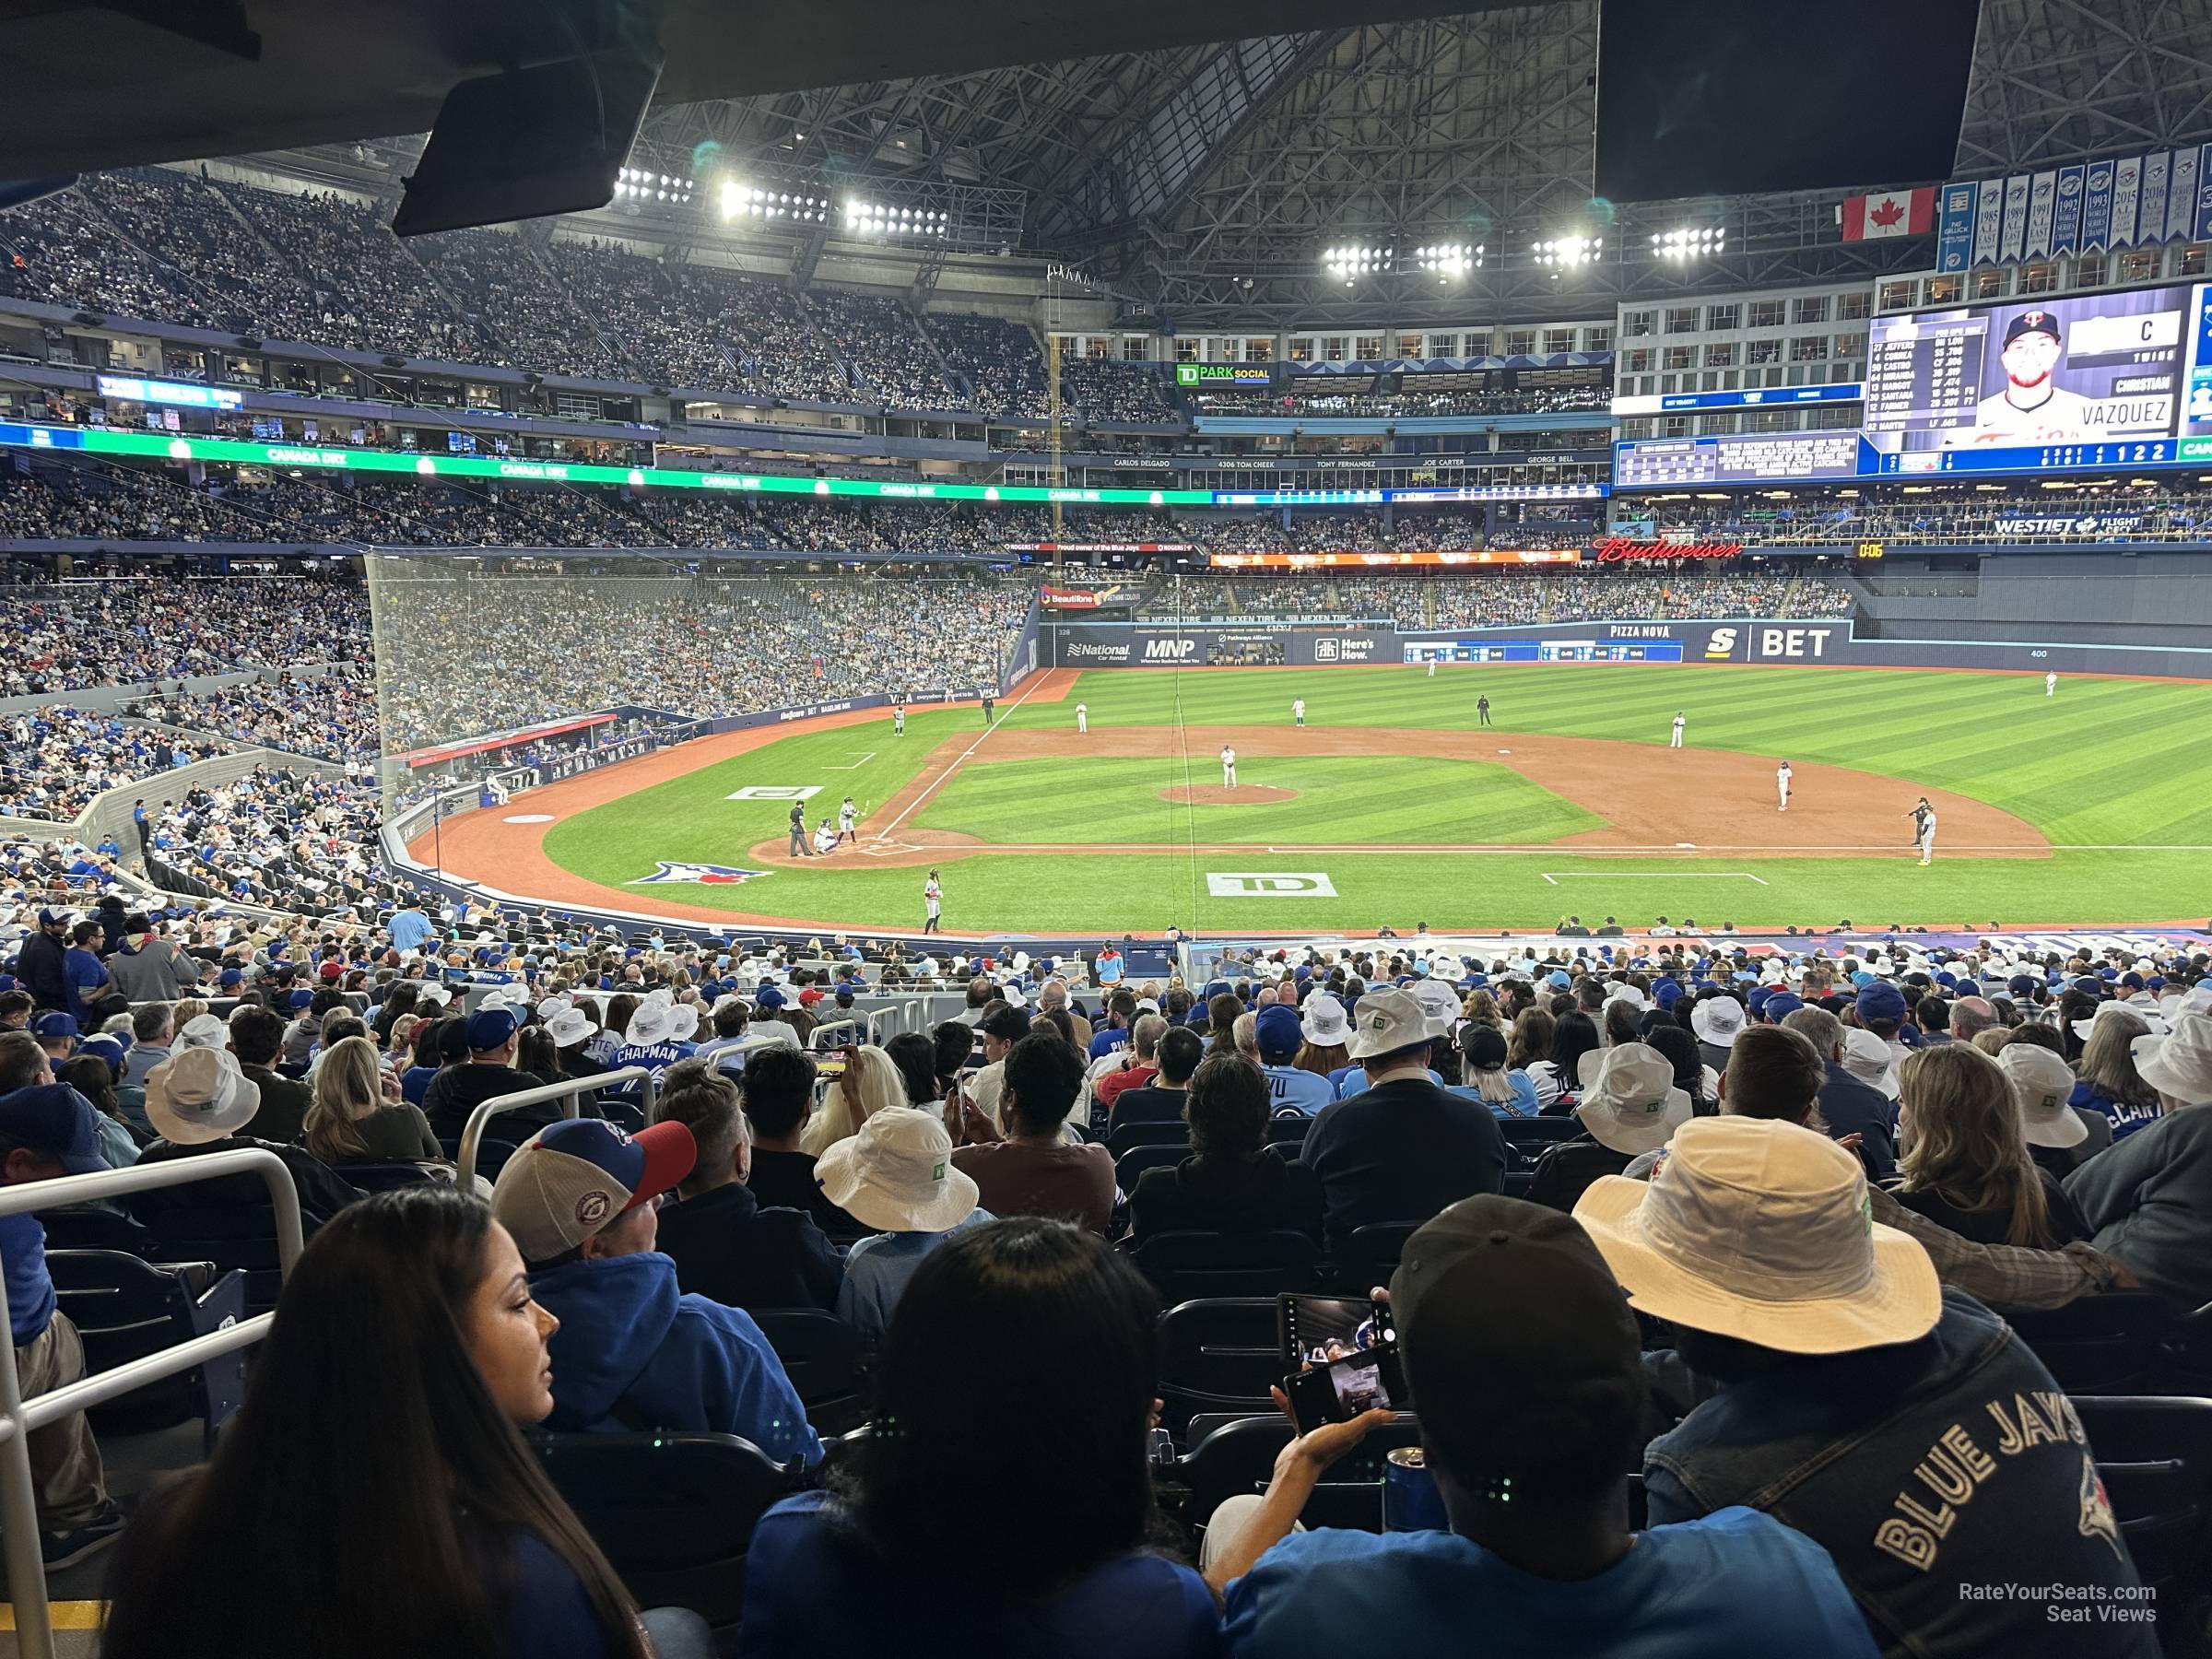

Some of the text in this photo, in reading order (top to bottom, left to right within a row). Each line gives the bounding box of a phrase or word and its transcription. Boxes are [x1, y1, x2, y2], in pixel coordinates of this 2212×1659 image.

[2115, 190, 2136, 205] 2015
[2144, 186, 2165, 200] 2016
[2059, 199, 2078, 213] 1992
[2088, 194, 2109, 208] 1993
[1980, 209, 1998, 223] 1985
[2006, 206, 2025, 220] 1989
[2031, 203, 2051, 217] 1991
[2141, 321, 2153, 341] C
[1874, 344, 1882, 352] 27
[2134, 350, 2174, 363] TWINS
[1884, 360, 1911, 371] CASTRO
[1178, 366, 1270, 382] TD PARK SOCIAL
[2115, 376, 2170, 394] CHRISTIAN
[266, 449, 347, 465] CANADA DRY
[2134, 445, 2146, 460] 2
[2152, 444, 2165, 459] 2
[500, 464, 543, 477] CANADA
[702, 476, 741, 488] CANADA
[880, 484, 916, 495] CANADA
[1049, 489, 1082, 500] CANADA
[2101, 517, 2140, 528] FLIGHT
[1126, 544, 1139, 552] Jays
[1593, 536, 1742, 562] Budweiser
[1859, 544, 1883, 558] 0:06
[1052, 594, 1093, 604] BeautiTone
[1226, 615, 1256, 623] NEXEN
[1257, 615, 1276, 623] TIRE
[1611, 626, 1670, 638] PIZZA NOVA
[1145, 640, 1195, 657] MNP
[1342, 639, 1374, 649] Here's
[1708, 628, 1831, 657] S BET
[1342, 650, 1368, 660] How.
[2030, 650, 2047, 658] 400
[978, 688, 1000, 699] VISA
[807, 707, 818, 716] BET
[1220, 877, 1318, 890] TD
[1375, 1018, 1384, 1029] TD
[618, 1045, 678, 1064] CHAPMAN
[1874, 1392, 2088, 1571] BLUE JAYS
